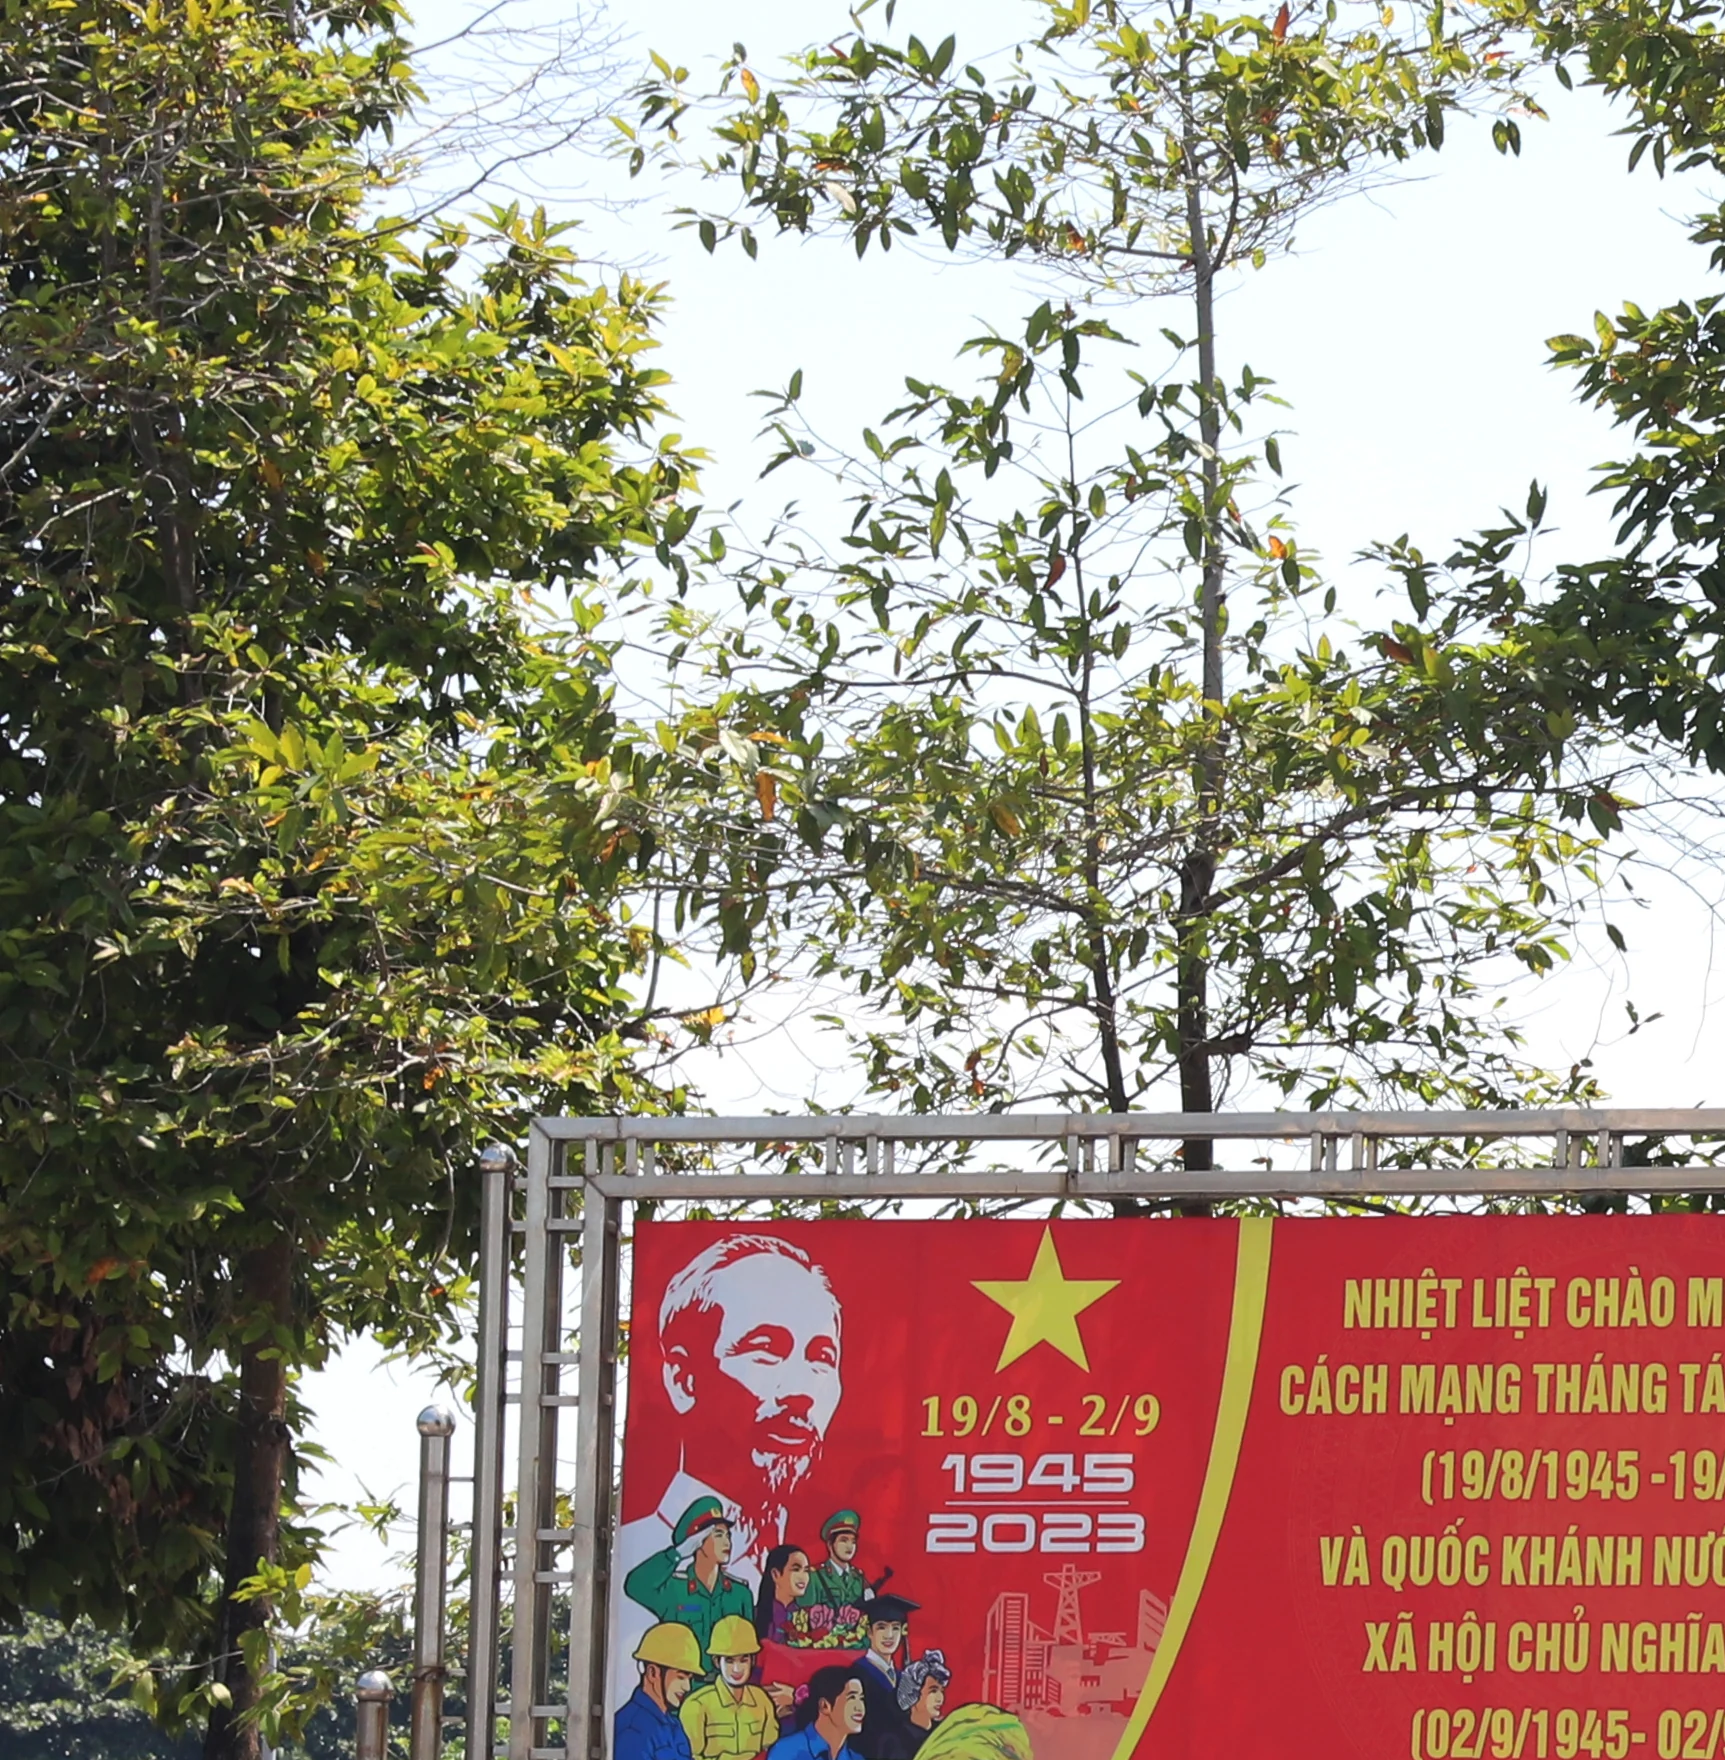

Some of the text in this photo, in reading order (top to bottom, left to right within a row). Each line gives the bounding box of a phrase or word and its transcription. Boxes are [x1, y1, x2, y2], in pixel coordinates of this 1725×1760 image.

[1344, 1268, 1462, 1339] NHIỆT
[1473, 1267, 1555, 1338] LIỆT
[1567, 1267, 1674, 1327] CHÀO
[922, 1395, 1032, 1437] 19/8
[1080, 1395, 1160, 1436] 2/9
[1281, 1355, 1387, 1415] CÁCH
[1400, 1364, 1520, 1424] MẠNG
[1533, 1354, 1666, 1413] THÁNG
[942, 1454, 1133, 1492] 1945
[1423, 1449, 1638, 1504] (19/8/1945
[927, 1514, 1144, 1552] 2023
[1321, 1526, 1369, 1585] VÀ
[1383, 1519, 1489, 1591] QUỐC
[1502, 1526, 1641, 1585] KHÁNH
[1364, 1613, 1416, 1671] XÃ
[1429, 1612, 1495, 1683] HỘI
[1508, 1606, 1589, 1672] CHỦ
